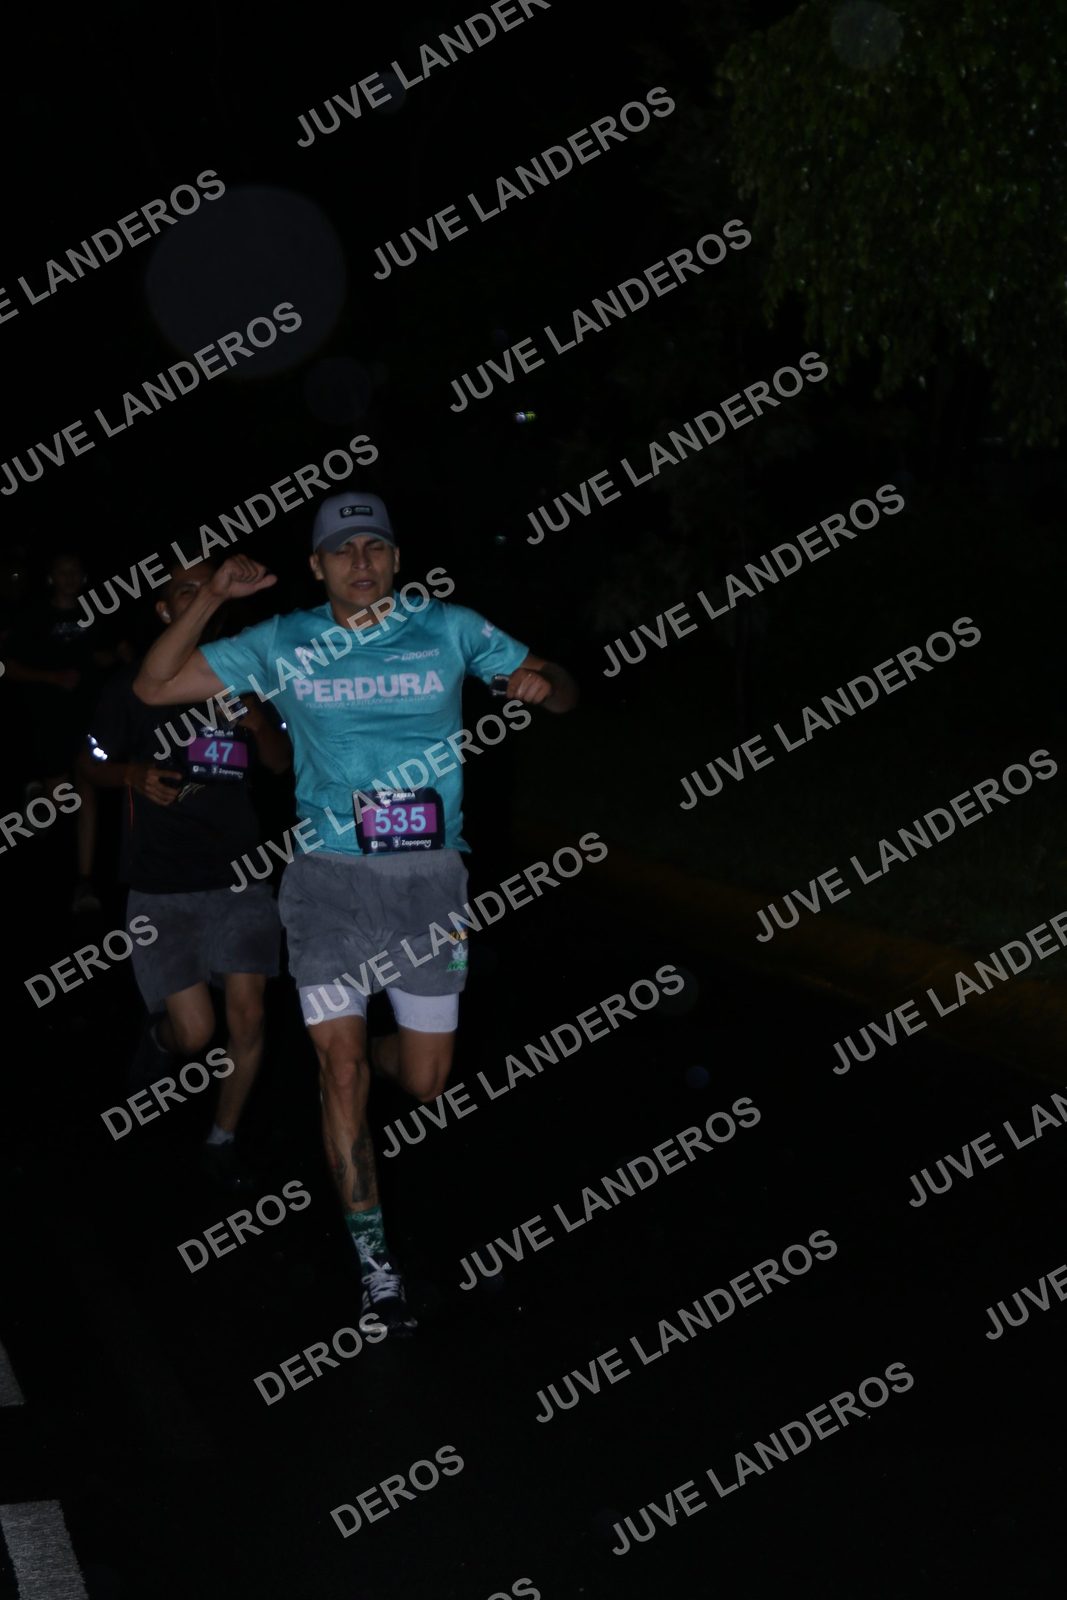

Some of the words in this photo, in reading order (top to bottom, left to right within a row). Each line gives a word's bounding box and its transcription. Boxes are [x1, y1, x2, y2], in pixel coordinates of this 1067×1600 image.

[293, 670, 444, 702] PERDURA
[204, 741, 233, 763] 47
[375, 806, 427, 833] 535
